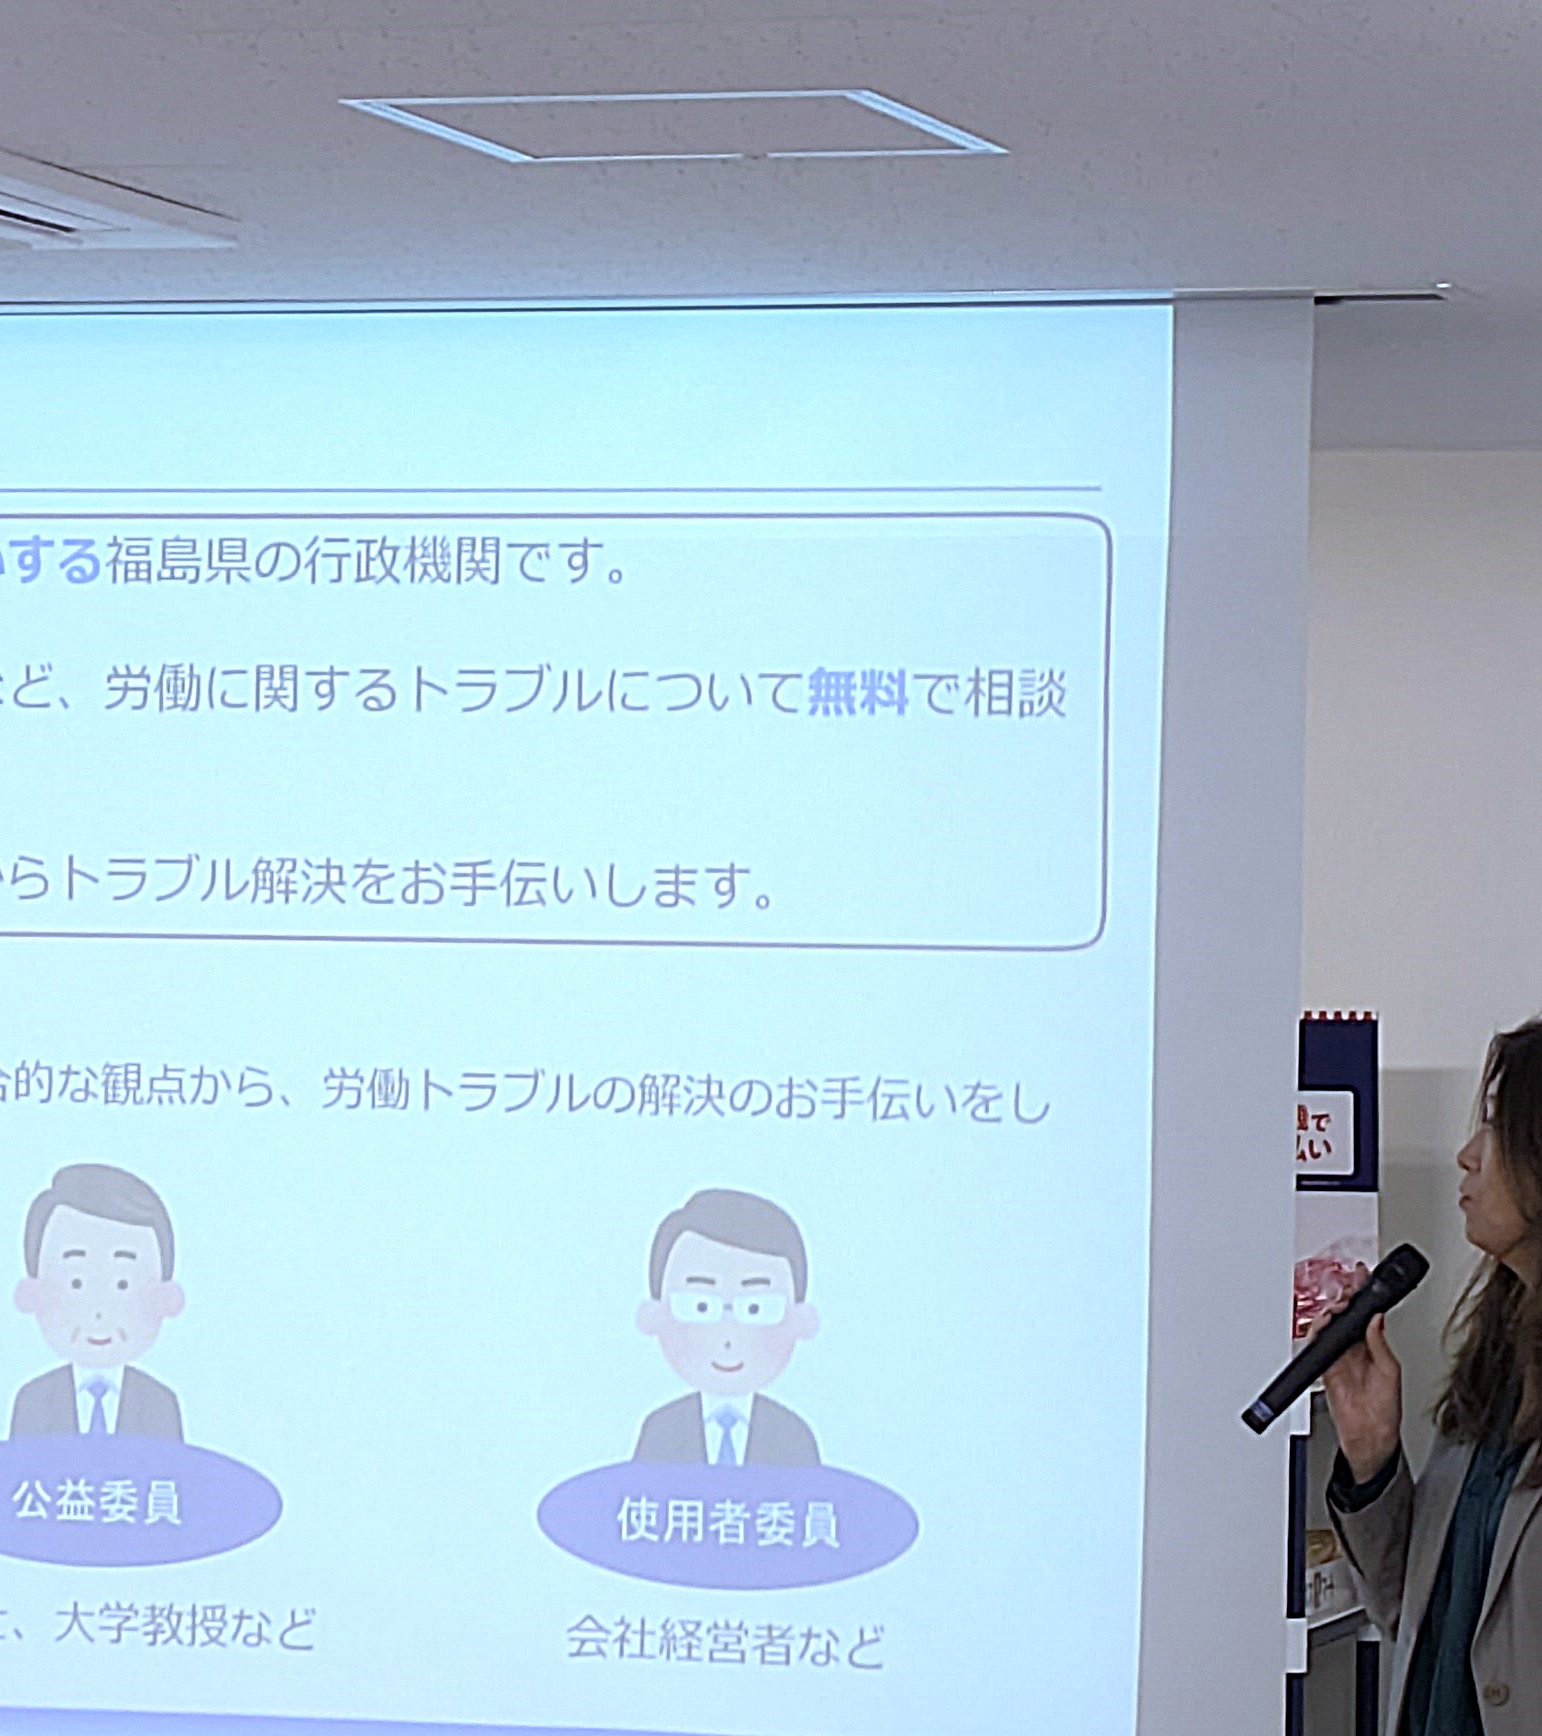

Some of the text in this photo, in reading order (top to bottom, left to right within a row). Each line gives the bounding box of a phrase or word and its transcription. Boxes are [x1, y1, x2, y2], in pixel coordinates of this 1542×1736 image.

[11, 1478, 182, 1525] 公益委員
[616, 1495, 841, 1549] 使用者委員
[565, 1614, 886, 1671] 会社経営者など
